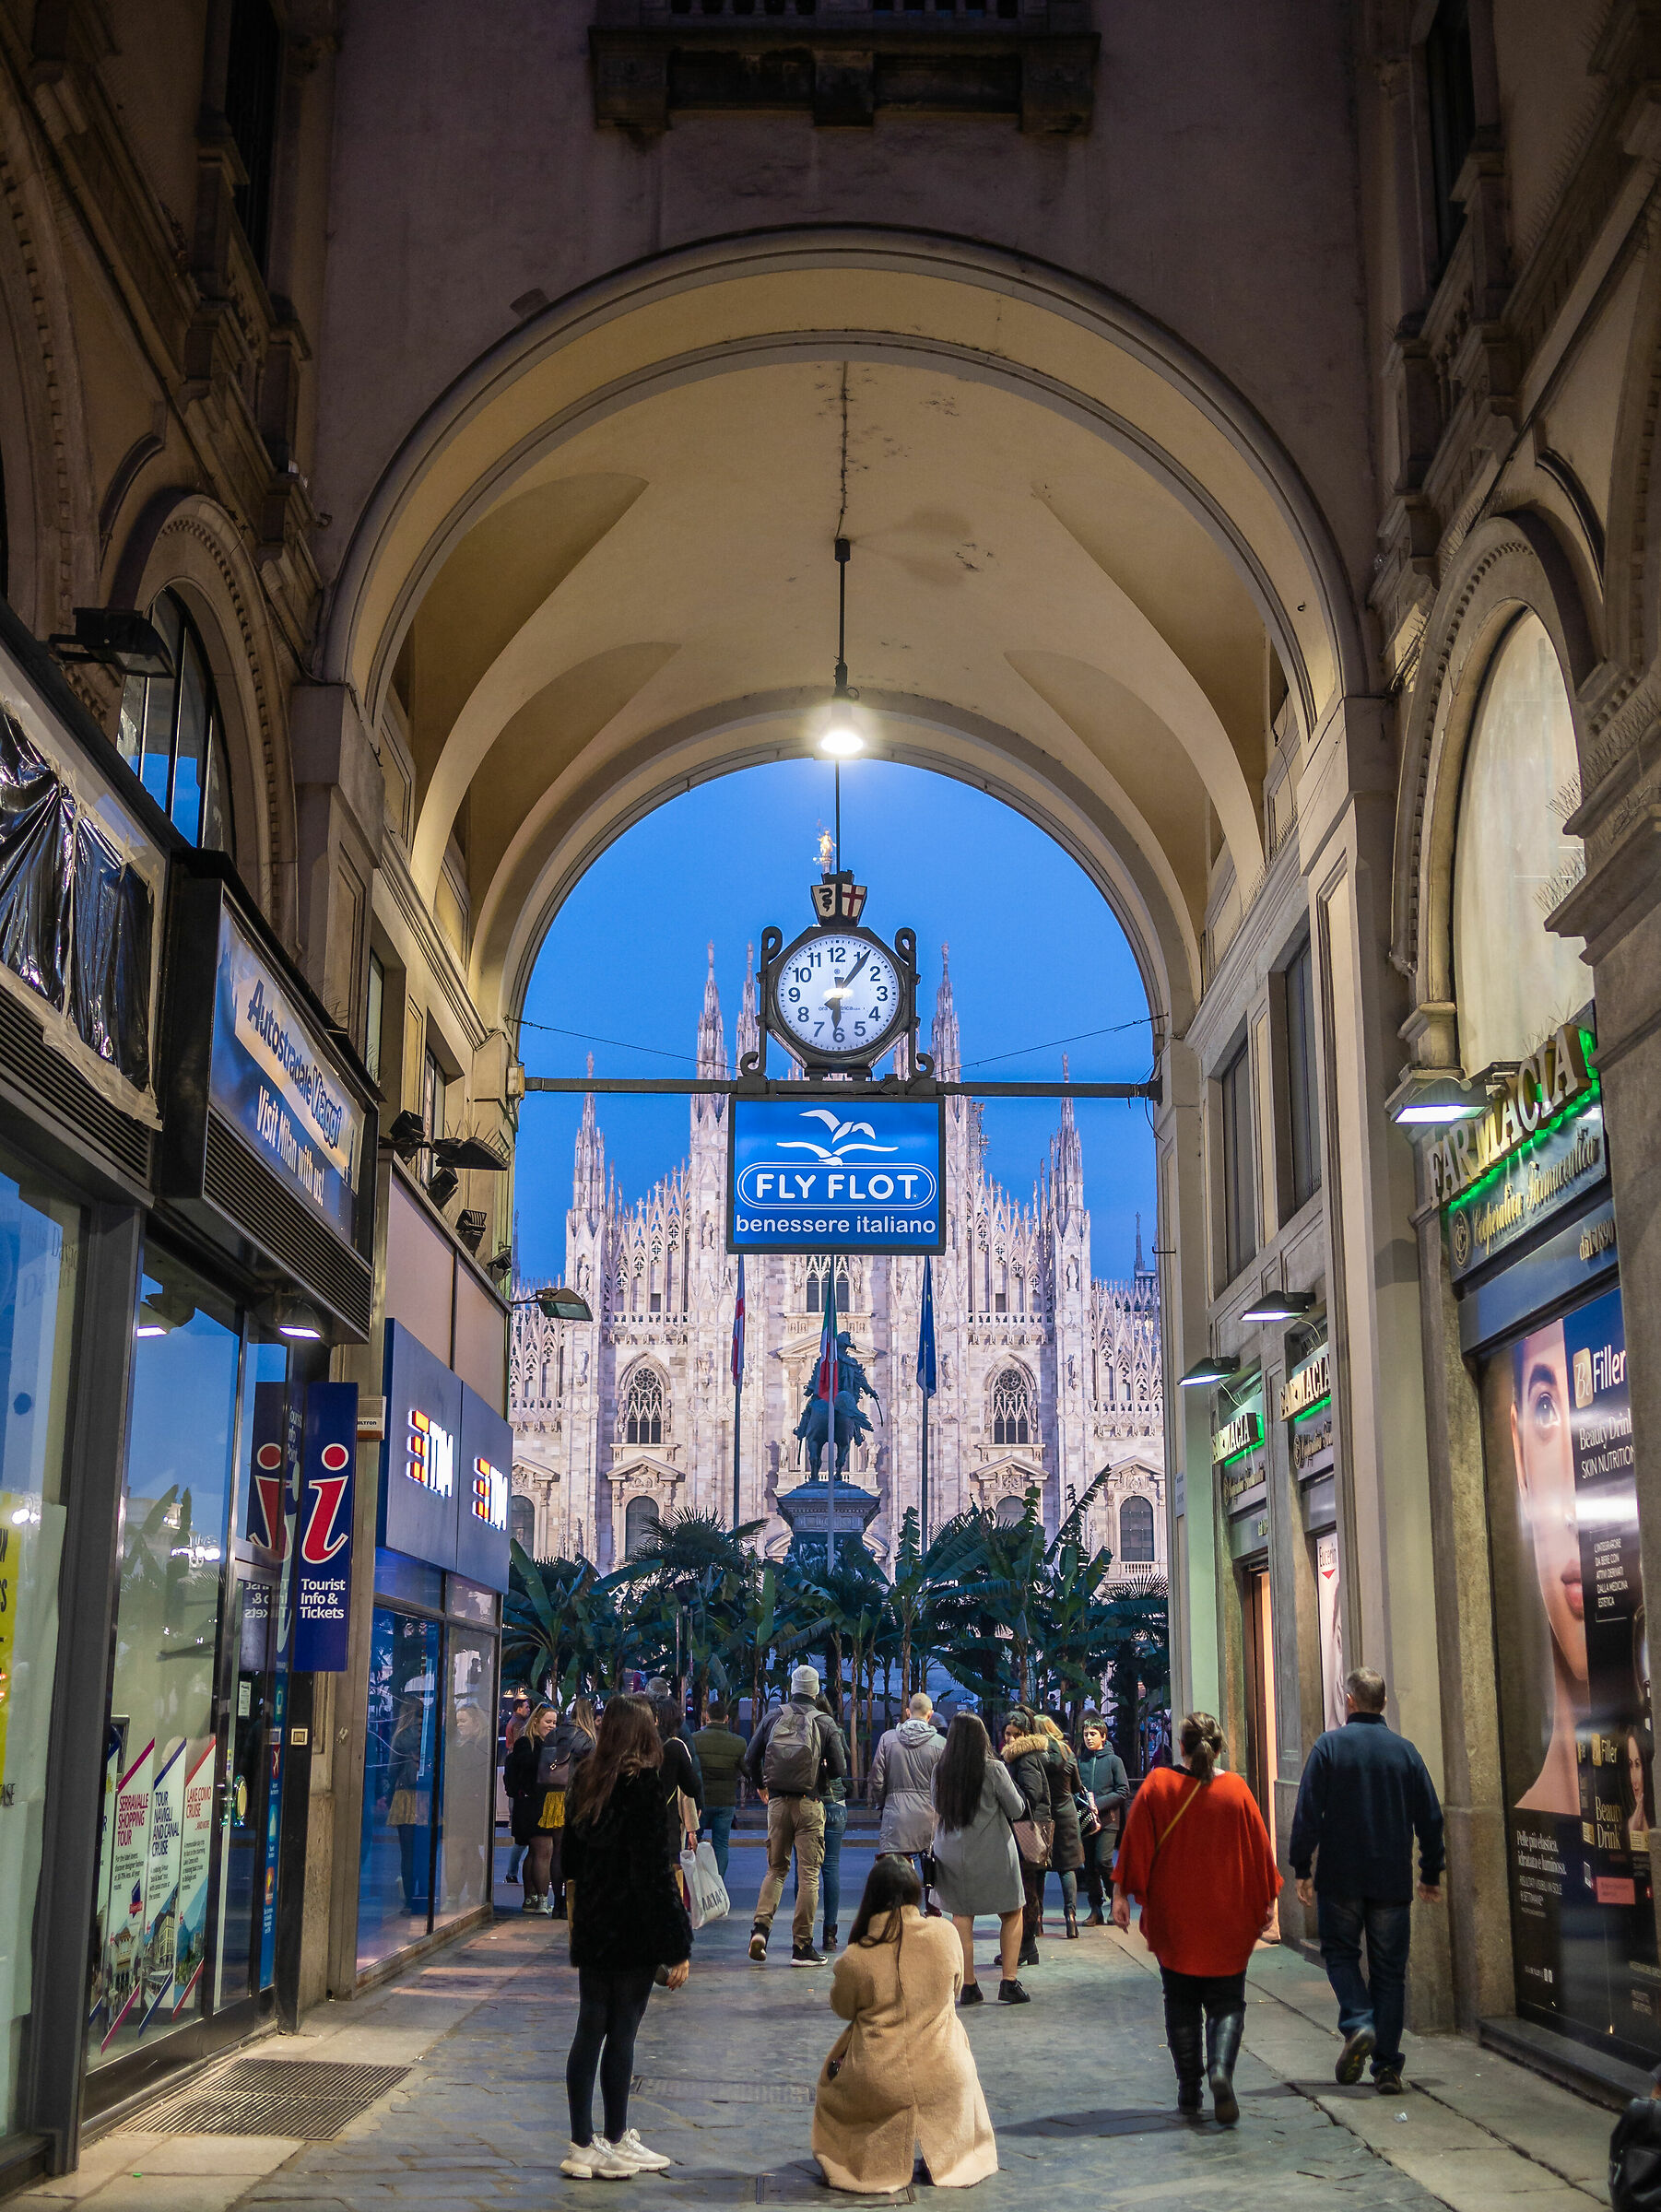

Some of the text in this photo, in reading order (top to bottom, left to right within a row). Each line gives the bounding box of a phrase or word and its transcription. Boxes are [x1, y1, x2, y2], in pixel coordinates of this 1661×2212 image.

[807, 952, 822, 968] 11
[827, 947, 846, 963] 12
[793, 967, 812, 983] 10
[869, 966, 881, 982] 2
[788, 987, 801, 1003] 9
[876, 985, 889, 1002] 3
[797, 1006, 809, 1022] 8
[868, 1006, 881, 1022] 4
[813, 1021, 825, 1038] 7
[832, 1028, 845, 1043] 6
[854, 1021, 866, 1038] 5
[311, 1065, 342, 1149] Viaggi
[1429, 1023, 1582, 1209] FARMACIA
[256, 1085, 325, 1206] Visit Milan with us!
[756, 1173, 919, 1200] FLY FLOT
[736, 1214, 937, 1234] benessere italiano
[1473, 1182, 1523, 1255] Cooperativa
[1579, 1229, 1593, 1261] dal
[1593, 1344, 1627, 1393] Filler
[1580, 1428, 1608, 1450] Beauty
[1582, 1456, 1597, 1479] SKIN
[301, 1578, 346, 1591] Tourist
[300, 1592, 338, 1605] Info &
[300, 1606, 345, 1619] Tickets
[119, 1793, 148, 1813] SERRAVALLE
[155, 1791, 169, 1808] TOUR
[186, 1786, 212, 1804] LAKE COMO
[118, 1810, 145, 1830] SHOPPING
[153, 1806, 173, 1825] NAVIGLI
[186, 1803, 202, 1819] CRUISE
[117, 1829, 133, 1848] TOUR
[152, 1821, 180, 1841] AND CANAL
[1516, 1830, 1528, 1847] Pelle
[1596, 1822, 1621, 1850] Drink
[151, 1839, 169, 1857] CRUISE
